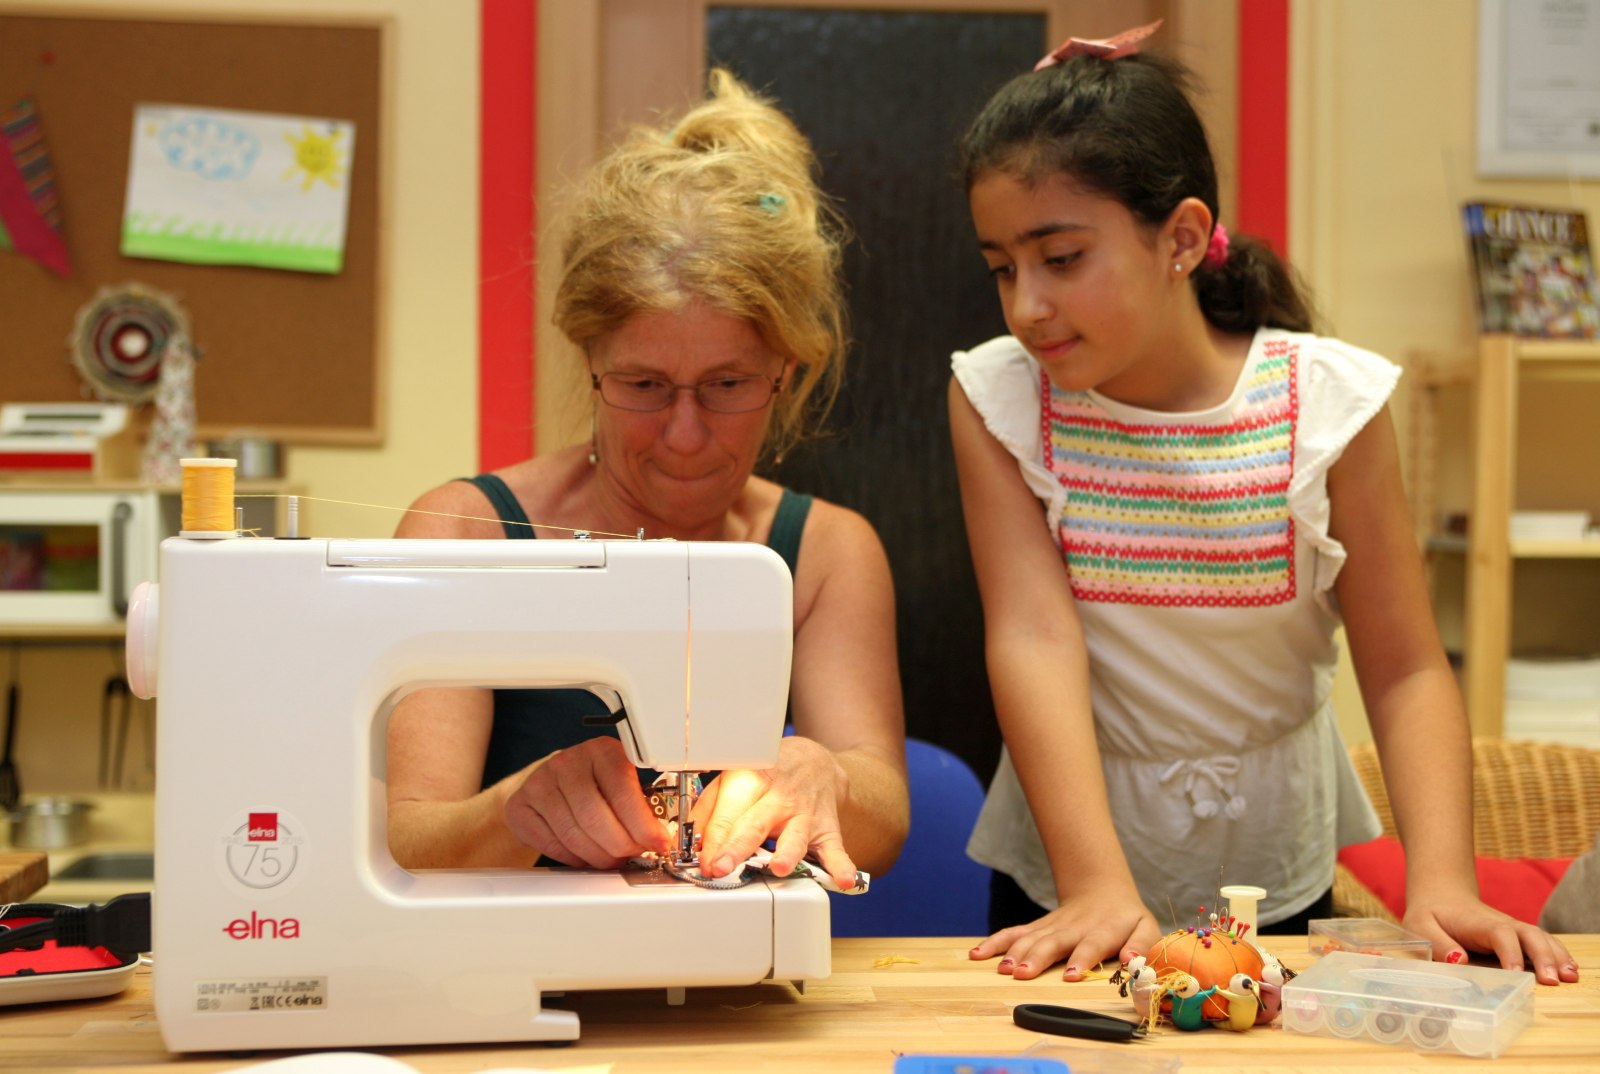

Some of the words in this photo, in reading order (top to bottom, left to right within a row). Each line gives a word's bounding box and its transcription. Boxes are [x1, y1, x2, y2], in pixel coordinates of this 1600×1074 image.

[249, 826, 276, 838] elna
[243, 844, 282, 878] 75
[222, 910, 300, 940] elna
[293, 993, 323, 1006] elna
